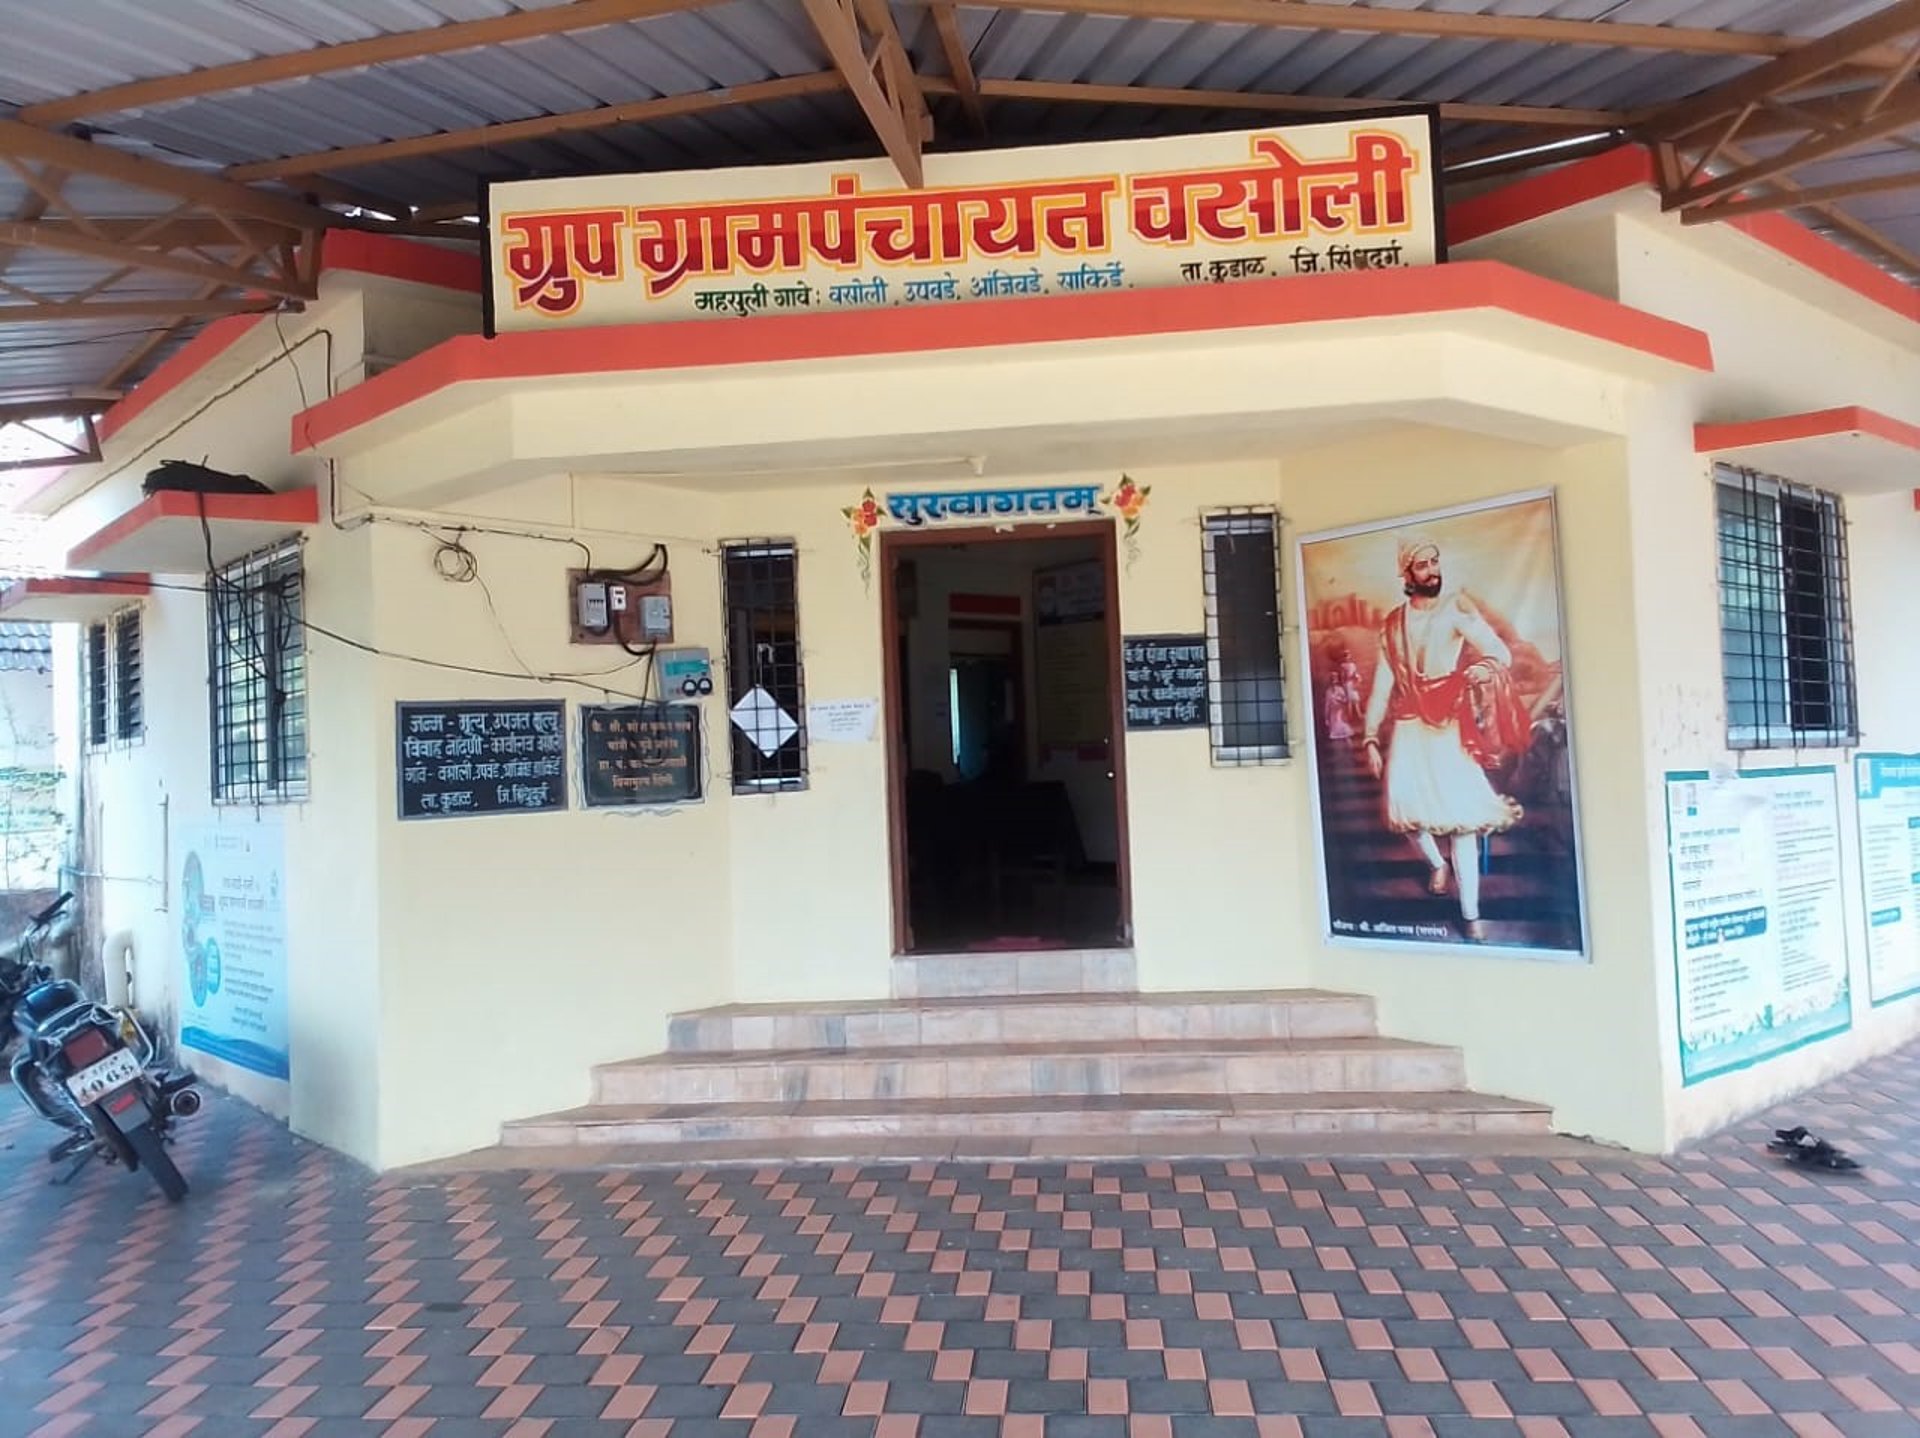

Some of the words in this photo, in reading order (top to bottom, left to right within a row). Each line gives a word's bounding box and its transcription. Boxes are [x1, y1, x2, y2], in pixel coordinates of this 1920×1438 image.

[503, 206, 628, 316] ग्रुप
[633, 172, 1121, 301] ग्रामपंचायत
[1125, 129, 1418, 246] वसोली
